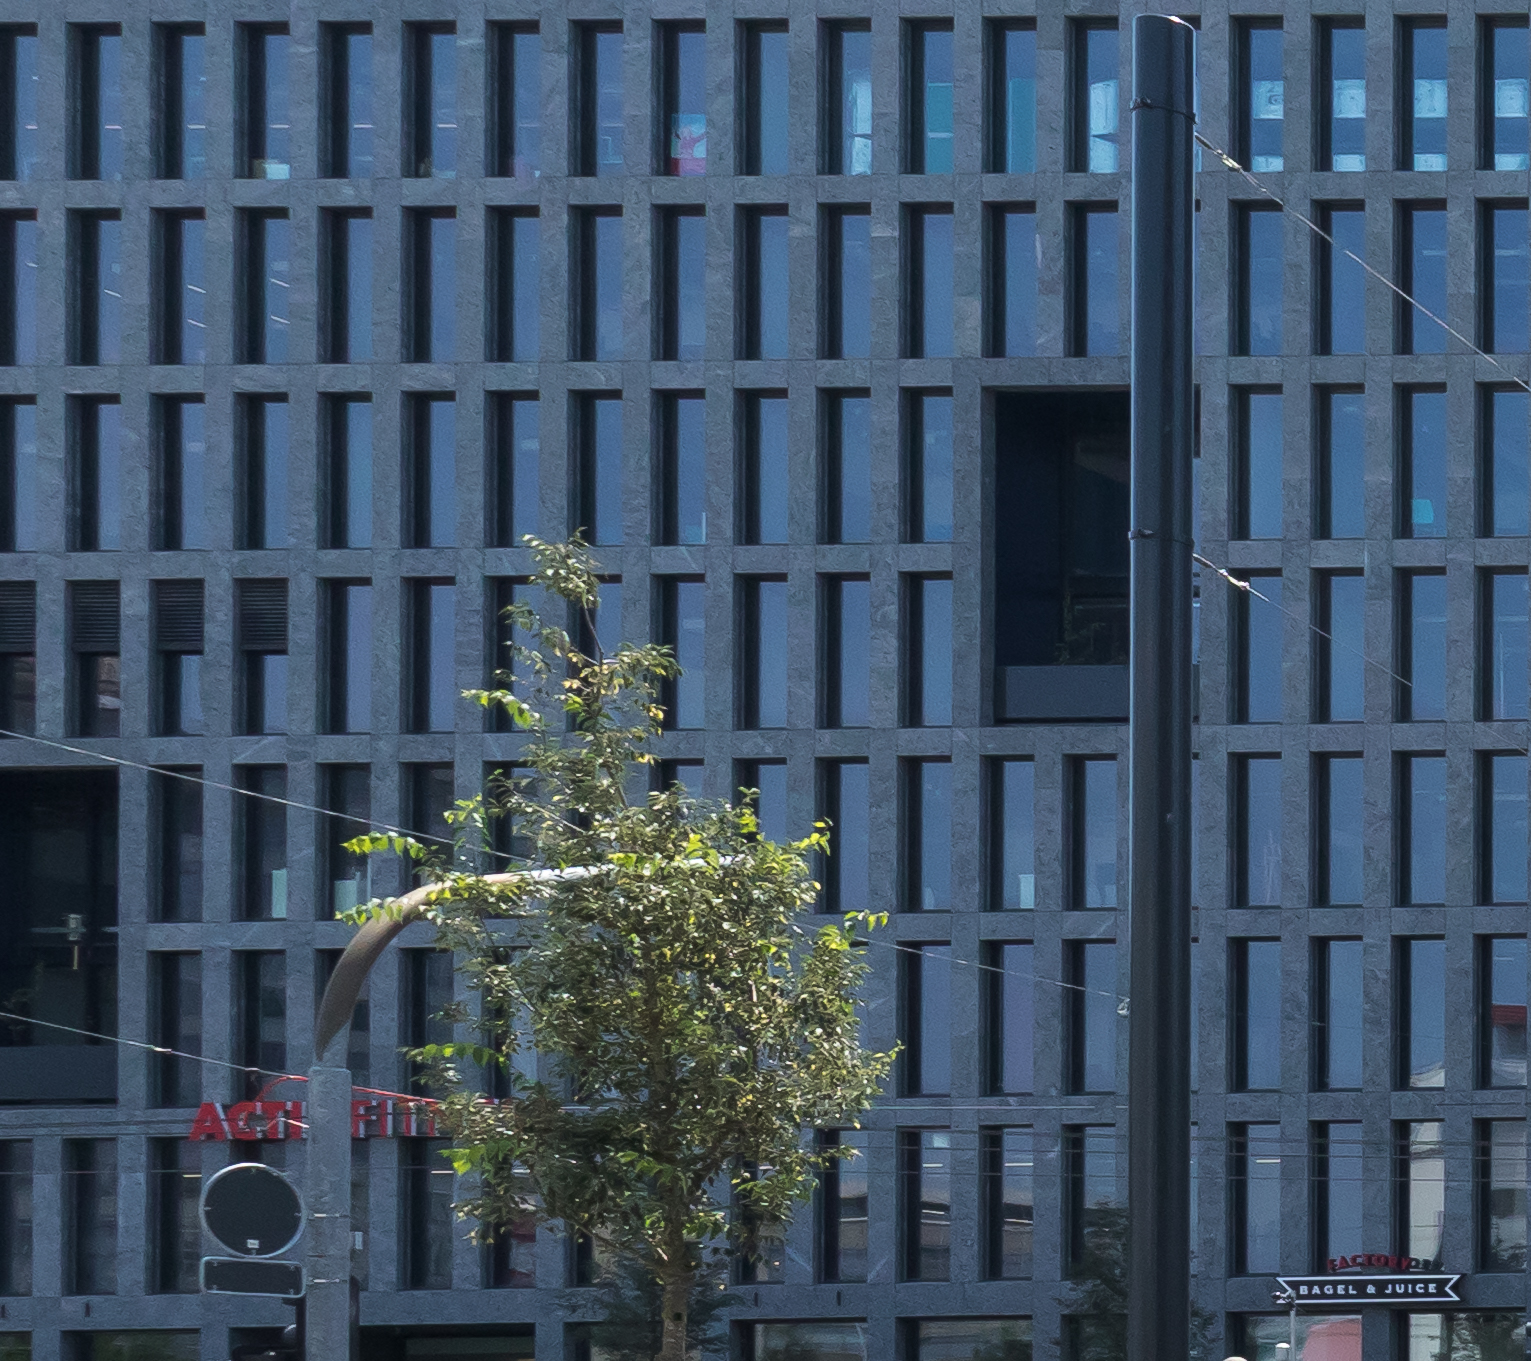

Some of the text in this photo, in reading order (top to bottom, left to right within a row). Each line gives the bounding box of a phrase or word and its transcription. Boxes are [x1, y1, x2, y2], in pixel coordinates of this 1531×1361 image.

[188, 1100, 308, 1141] ACTI
[1299, 1283, 1438, 1295] BAGEL & JUICE
